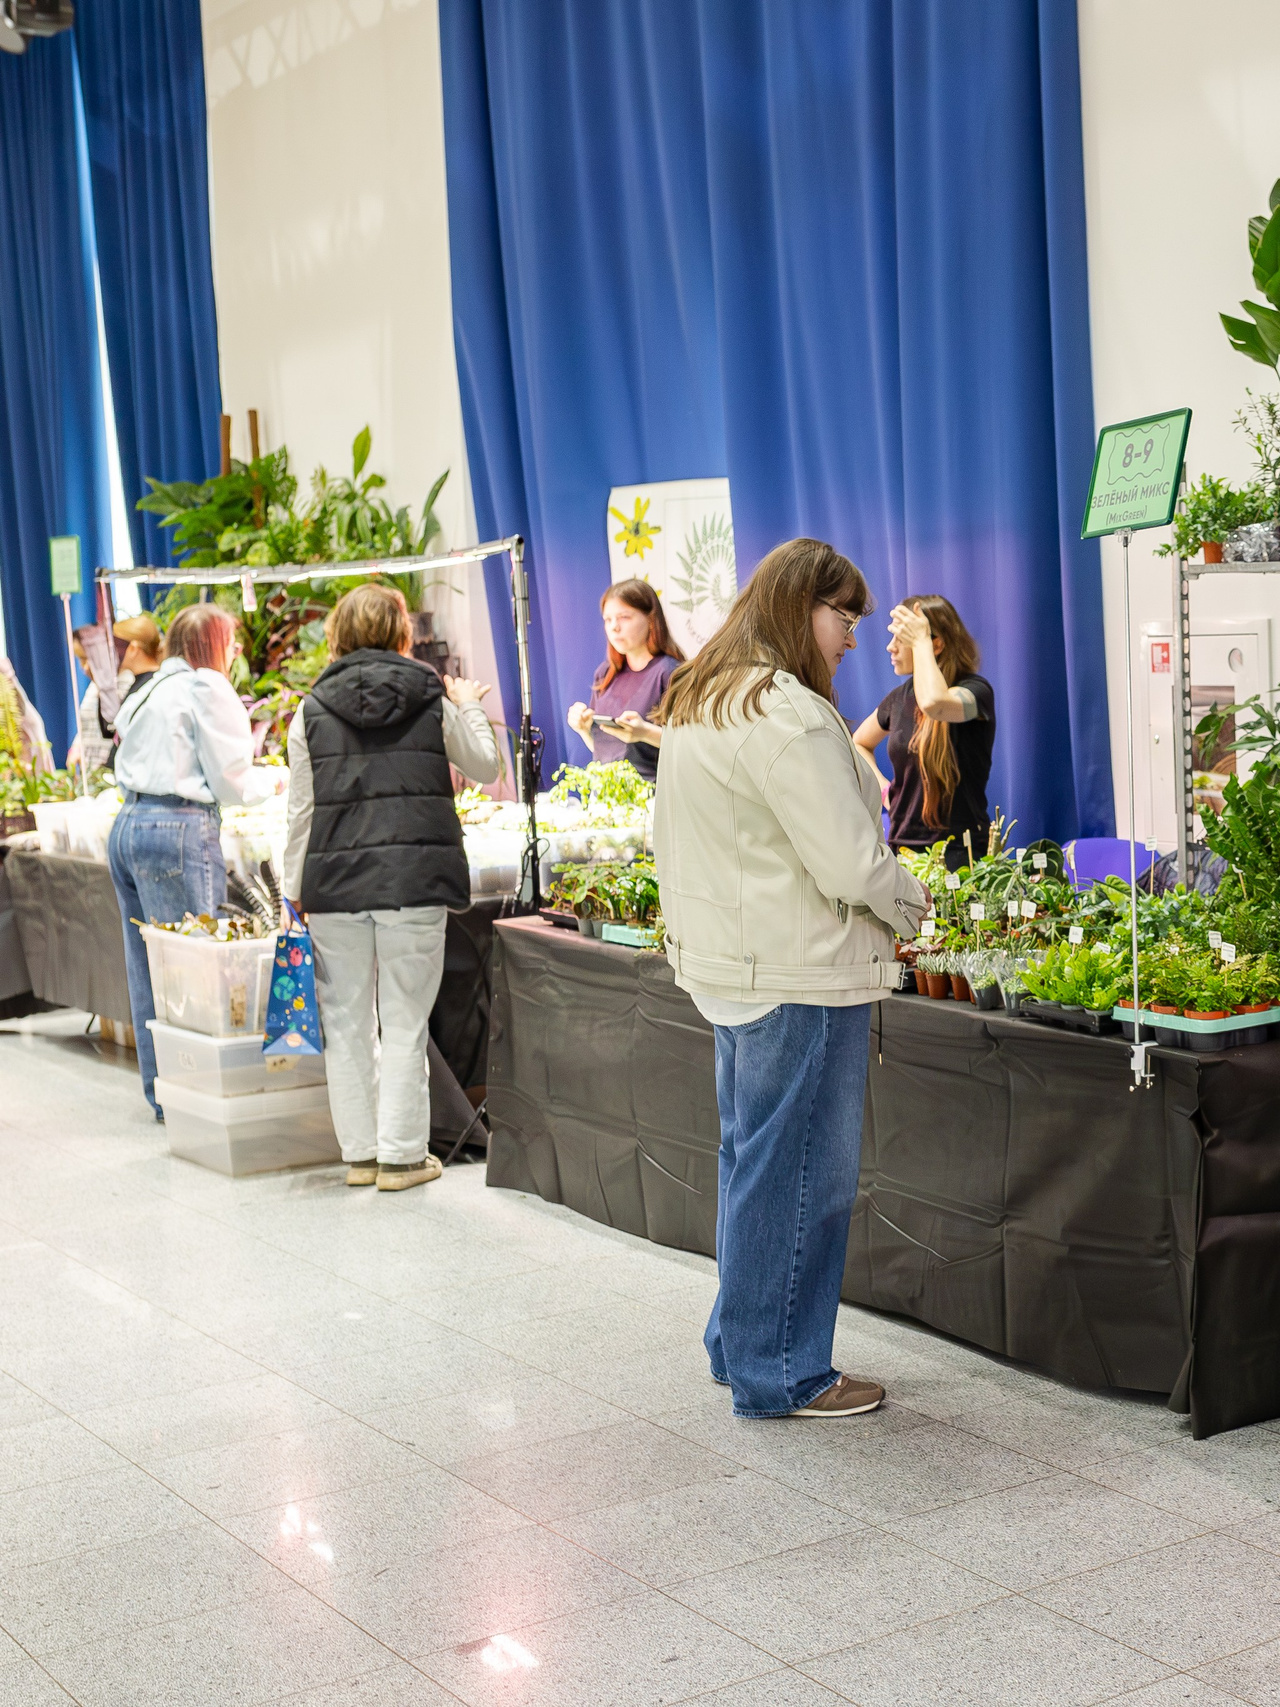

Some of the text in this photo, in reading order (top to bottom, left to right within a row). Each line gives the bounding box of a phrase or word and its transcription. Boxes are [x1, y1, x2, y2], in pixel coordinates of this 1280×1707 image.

[1122, 438, 1154, 468] 8-9
[1091, 481, 1171, 509] ЗЕЛЁНЫЙ МИКС
